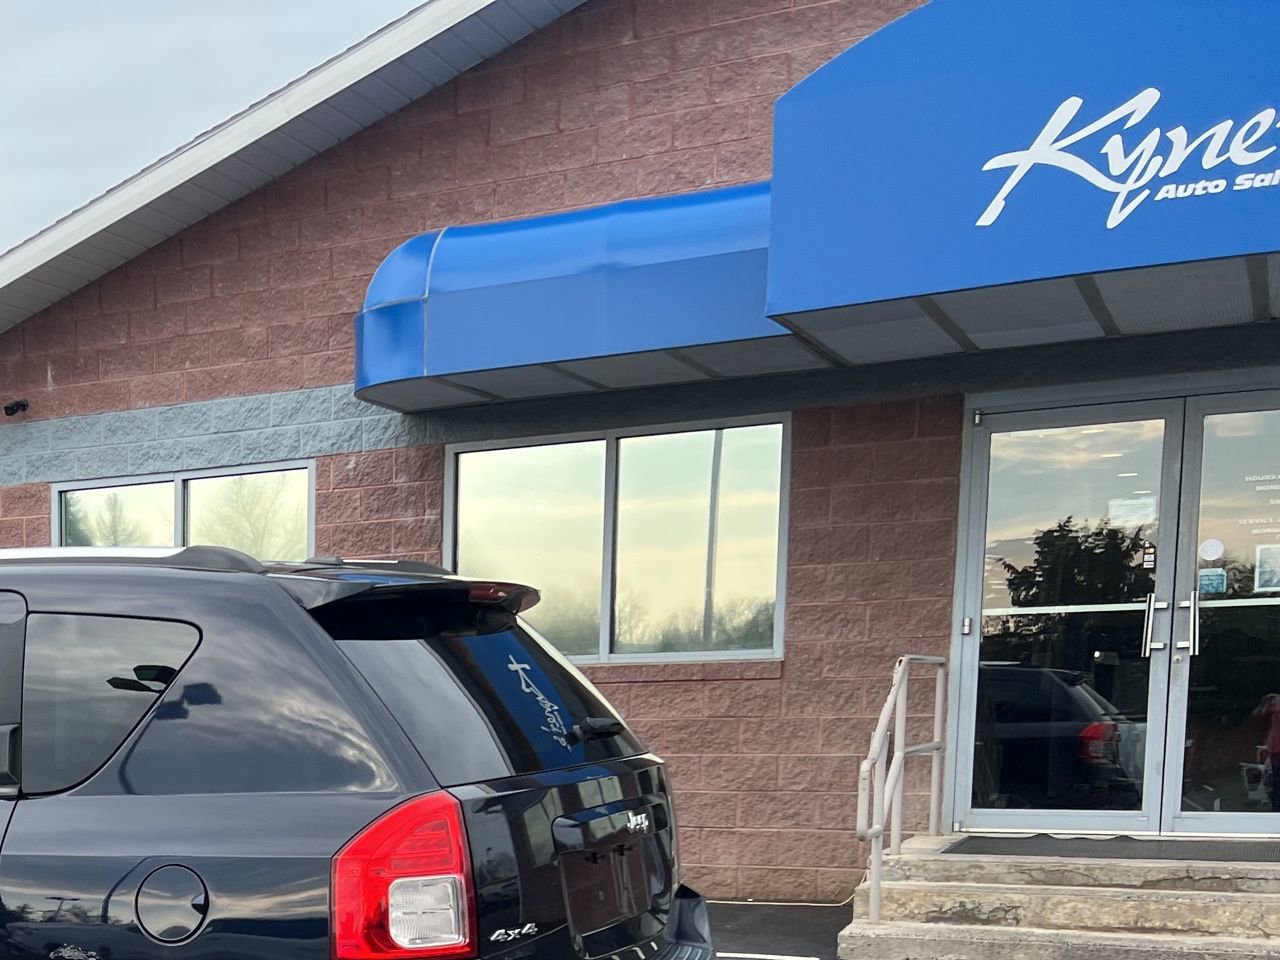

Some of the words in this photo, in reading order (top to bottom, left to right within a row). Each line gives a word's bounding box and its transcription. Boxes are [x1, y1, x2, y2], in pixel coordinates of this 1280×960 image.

[975, 87, 1280, 229] Kyne
[1153, 179, 1227, 201] Auto
[490, 922, 538, 942] 4x4
